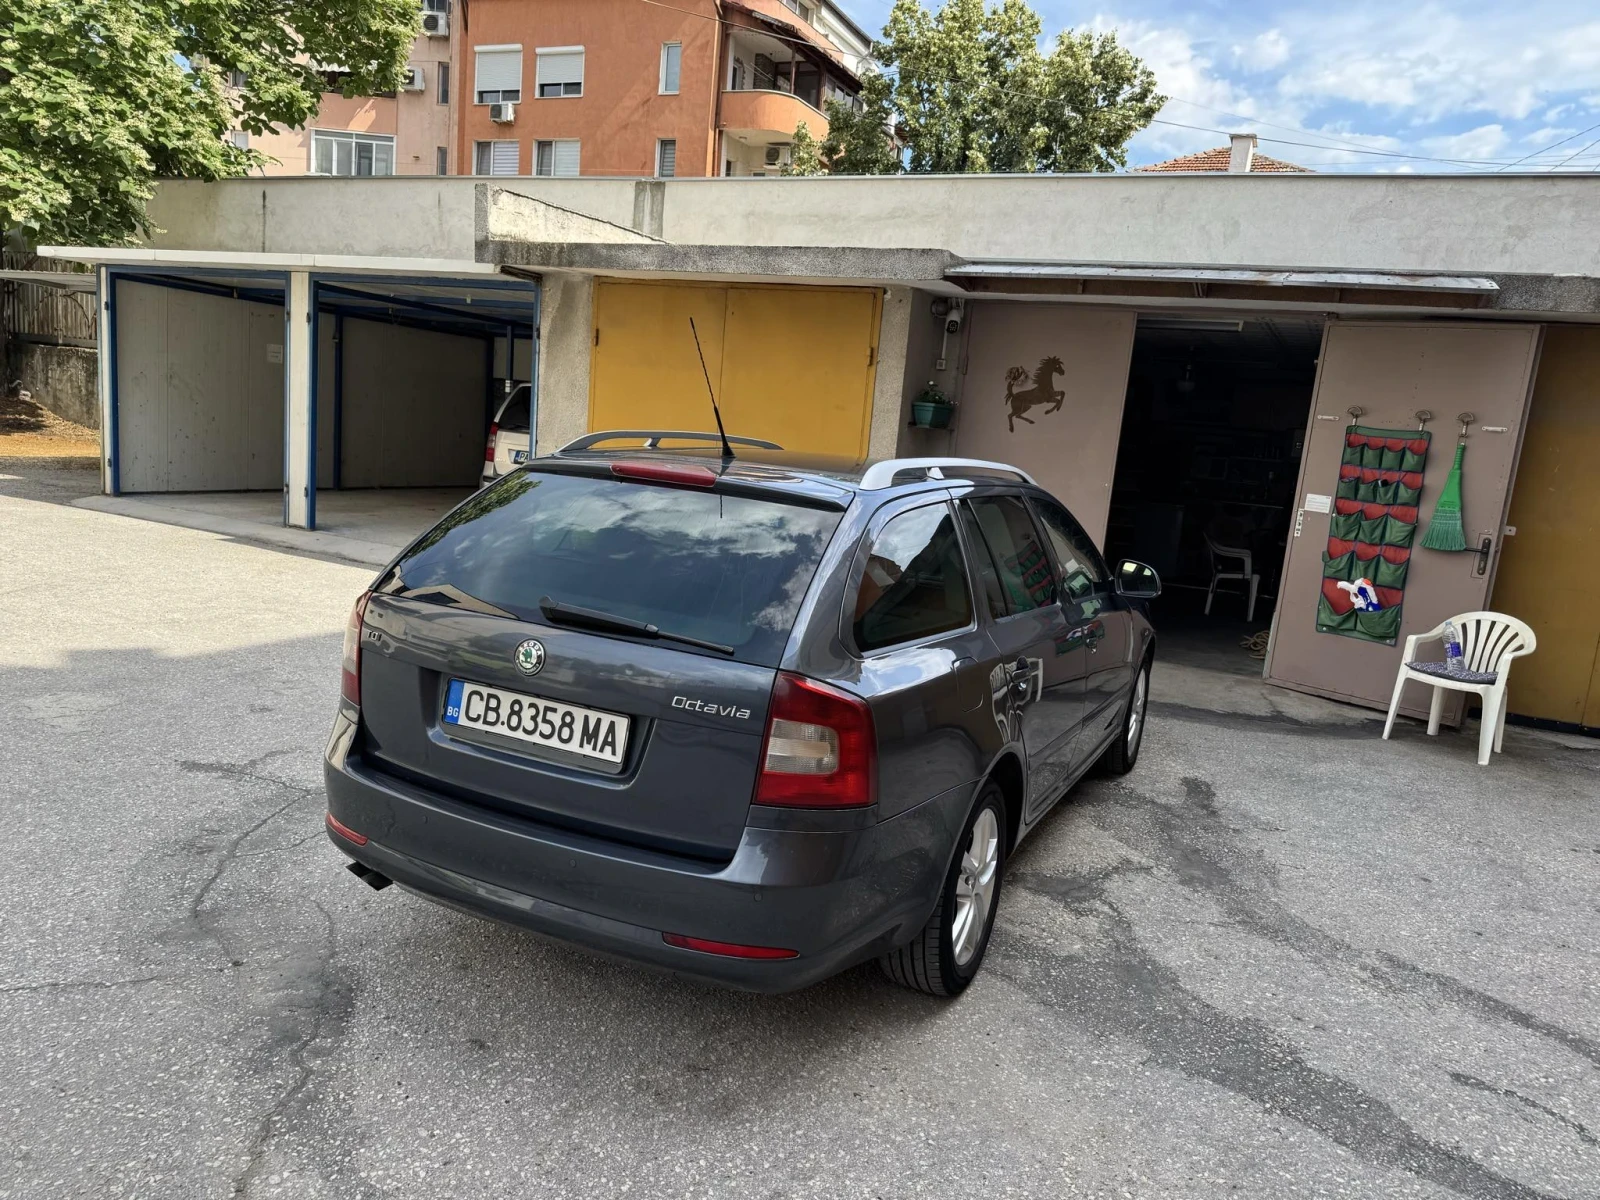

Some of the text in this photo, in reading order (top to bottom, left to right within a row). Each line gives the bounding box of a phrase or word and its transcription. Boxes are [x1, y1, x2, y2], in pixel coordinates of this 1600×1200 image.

[447, 706, 459, 718] BG
[671, 695, 751, 720] Octavia
[578, 714, 617, 756] MA
